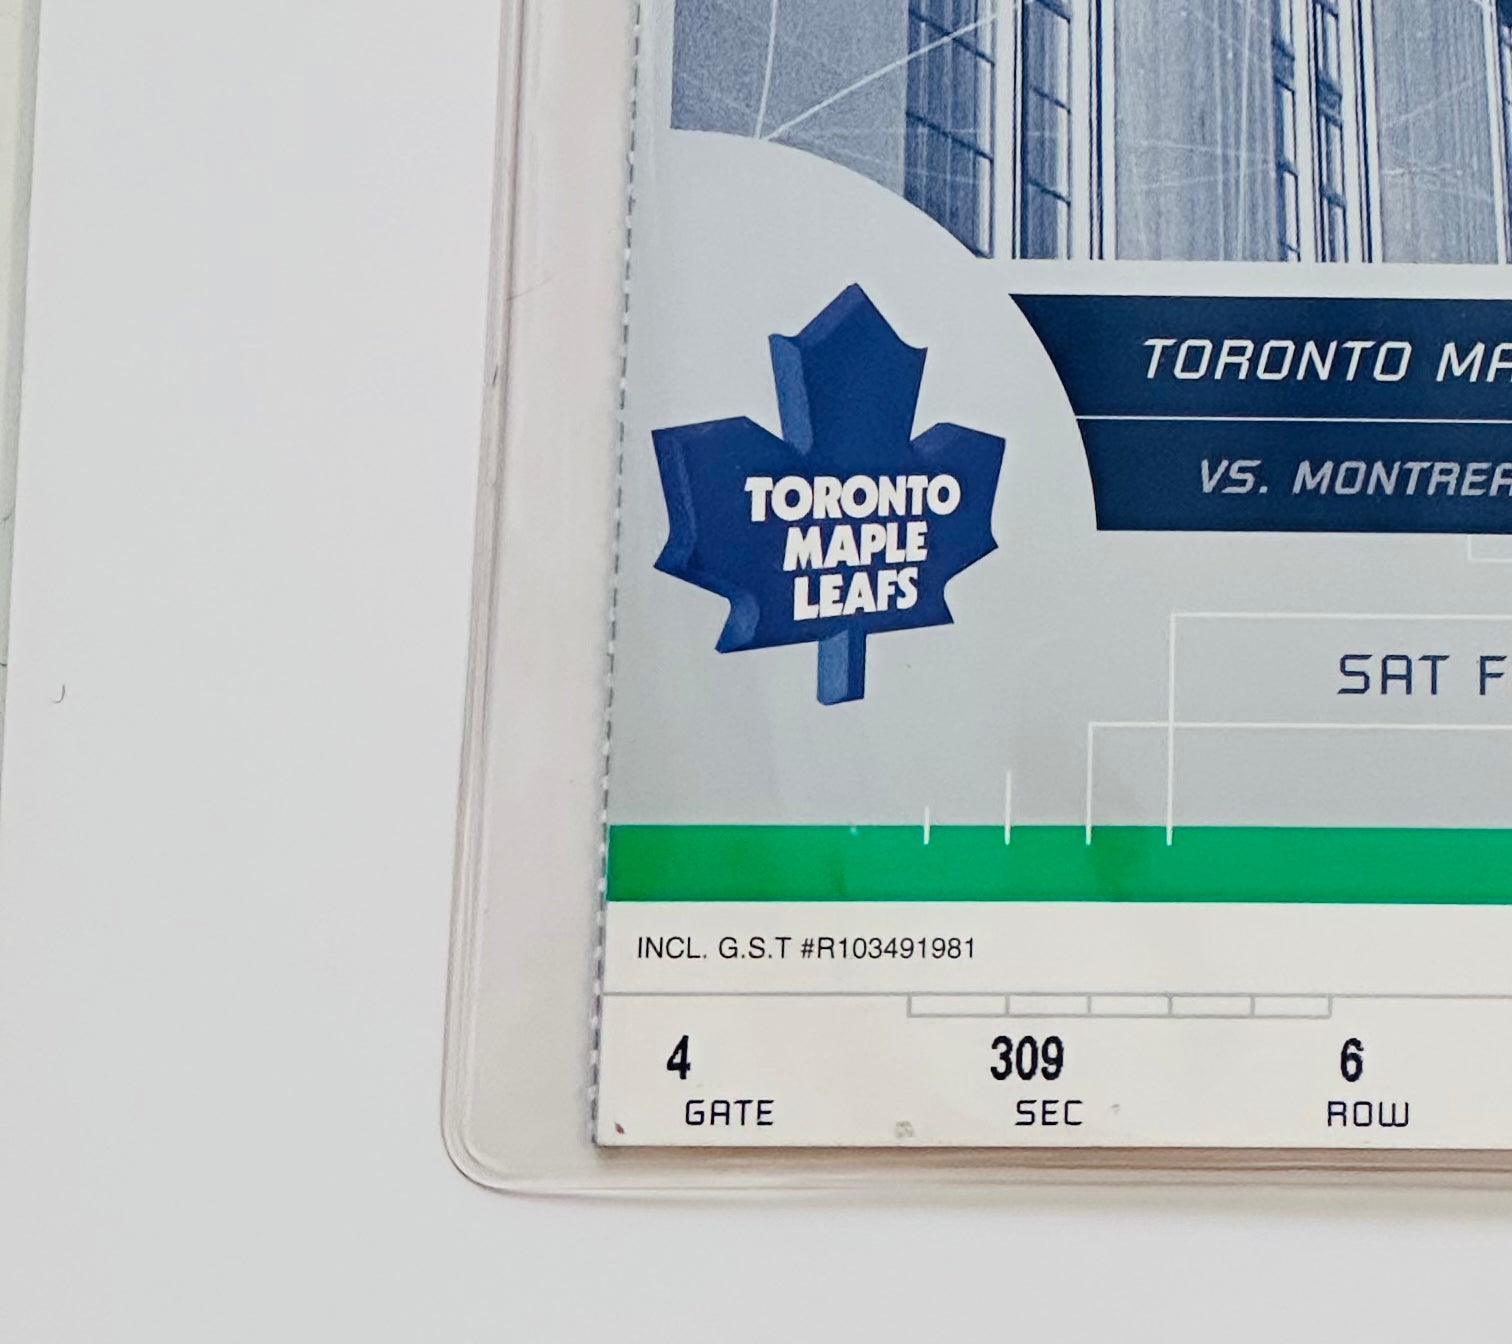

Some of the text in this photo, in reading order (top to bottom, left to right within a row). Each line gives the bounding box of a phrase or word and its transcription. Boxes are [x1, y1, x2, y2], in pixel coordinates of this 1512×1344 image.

[1144, 339, 1412, 381] TORONTO
[1201, 459, 1267, 493] VS.
[744, 473, 961, 523] TORONTO
[782, 520, 928, 572] MAPLE
[792, 567, 920, 621] LEAFS
[1337, 655, 1449, 695] SAT
[638, 937, 973, 959] INCL. G.S.T #R103491981
[667, 1035, 690, 1080] 4
[991, 1036, 1064, 1080] 309
[1341, 1038, 1364, 1082] 6
[686, 1100, 773, 1125] GATE
[1015, 1100, 1082, 1125] SEC
[1328, 1101, 1408, 1127] ROW
